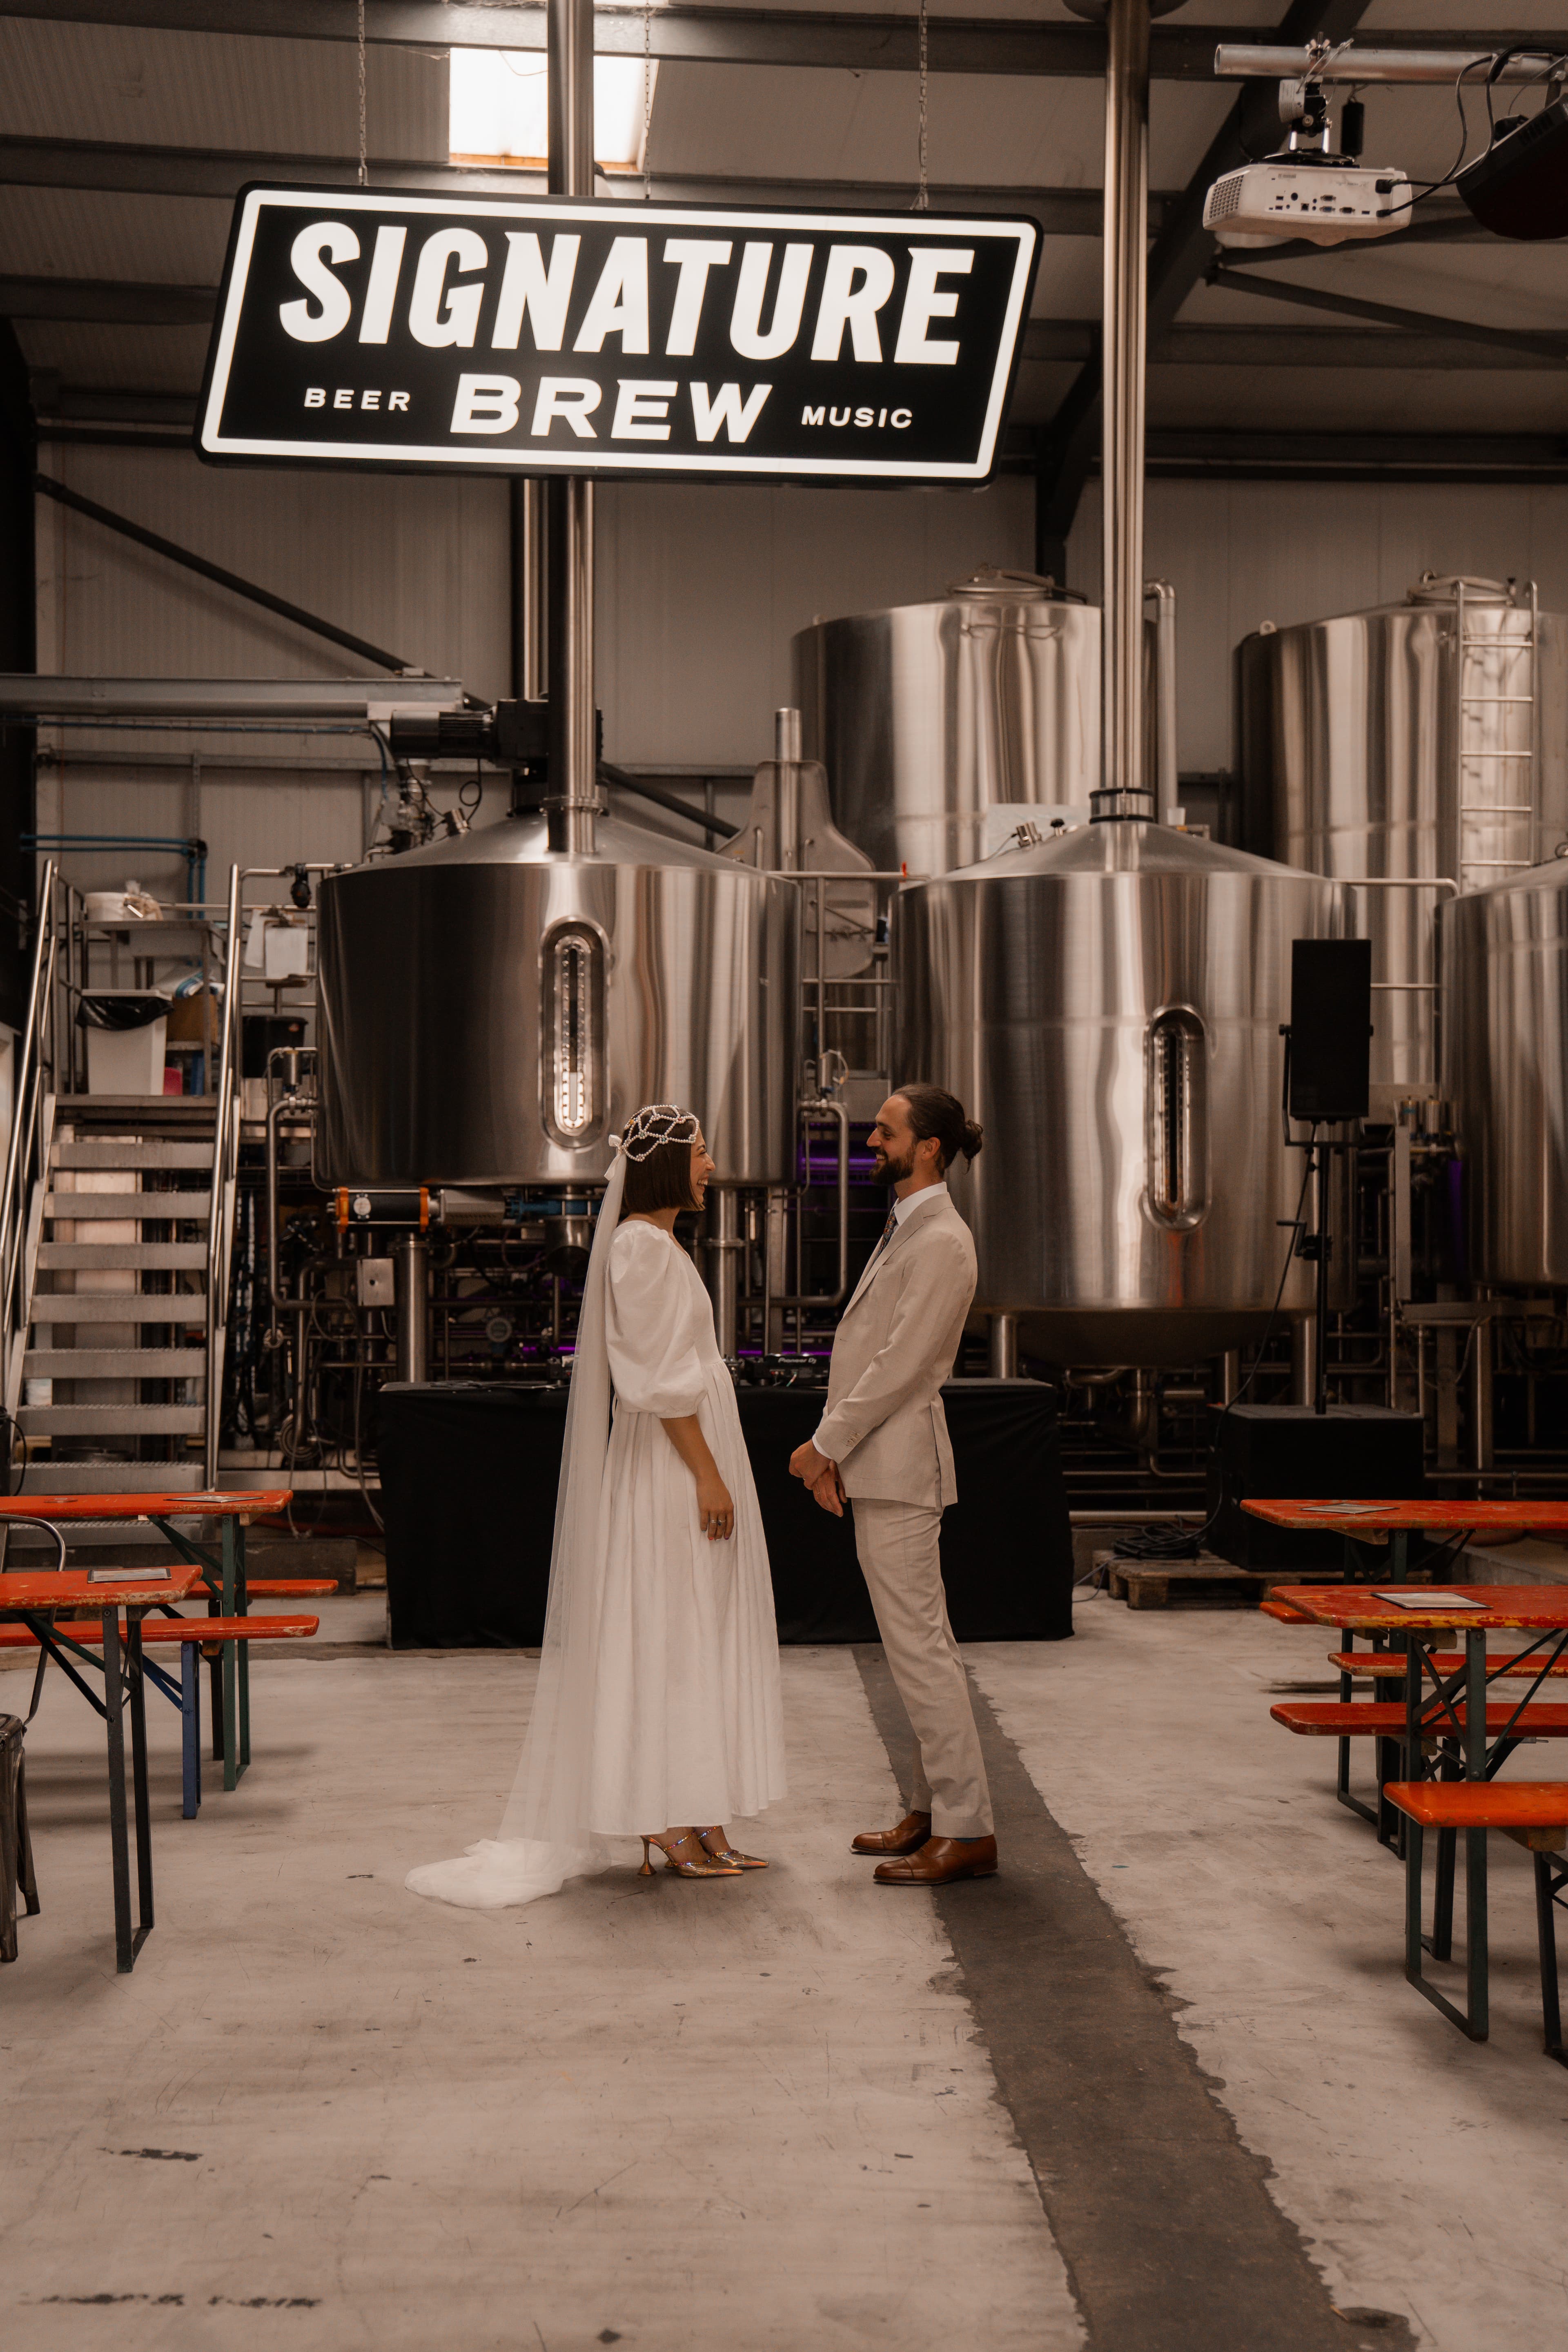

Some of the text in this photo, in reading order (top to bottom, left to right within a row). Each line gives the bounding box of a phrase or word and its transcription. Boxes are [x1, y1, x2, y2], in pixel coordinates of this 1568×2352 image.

[279, 221, 975, 365] SIGNATURE
[304, 388, 410, 412] BEER
[450, 373, 773, 443] BREW
[801, 405, 913, 429] MUSIC
